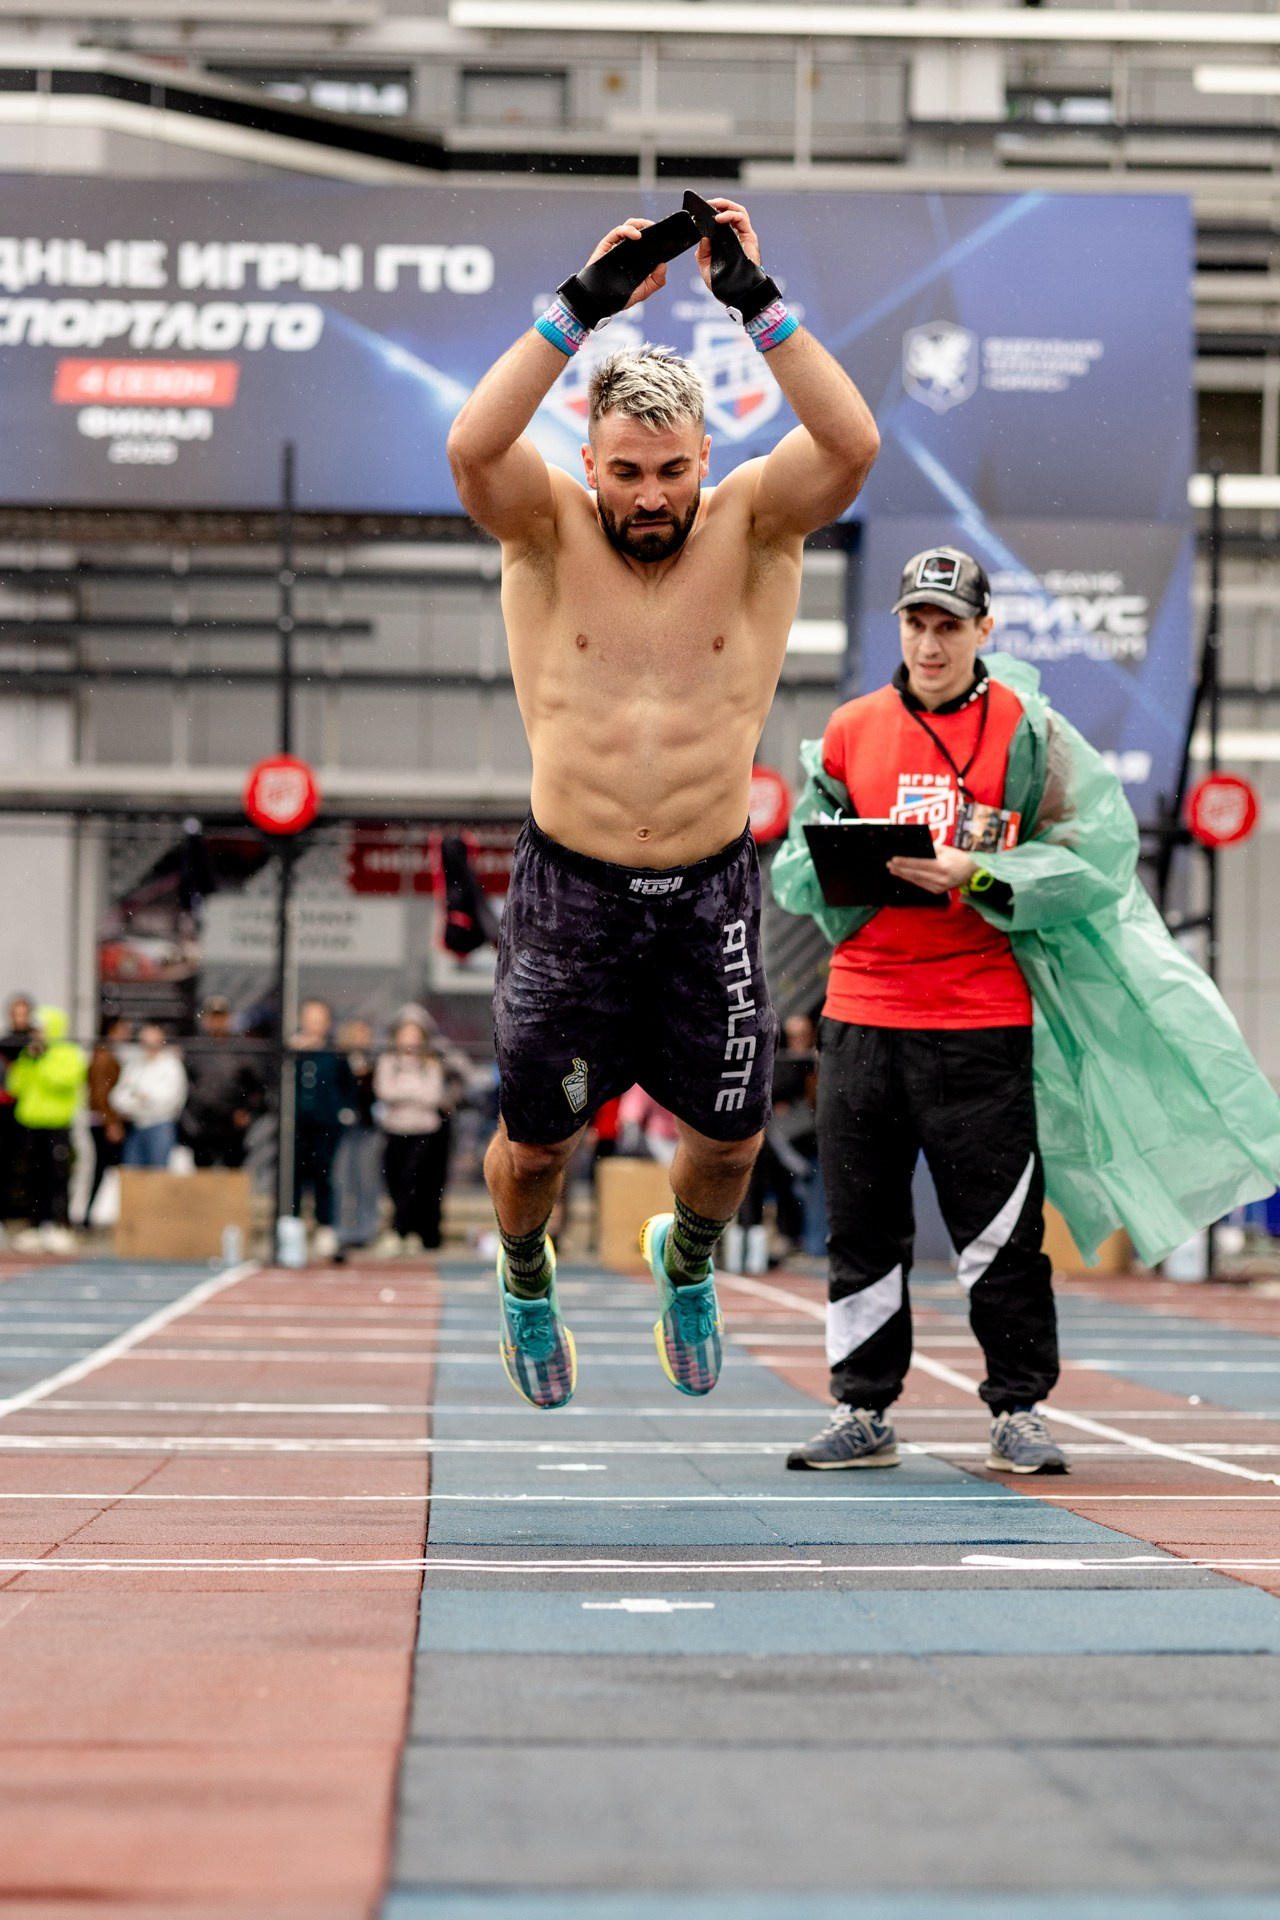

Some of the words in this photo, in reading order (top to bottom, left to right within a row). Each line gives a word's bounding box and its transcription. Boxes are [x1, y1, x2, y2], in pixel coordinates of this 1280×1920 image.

[178, 241, 362, 292] ИГРЫ
[375, 244, 495, 294] ГТО
[898, 773, 951, 786] ИГРЫ
[714, 919, 757, 1112] ATHLETE
